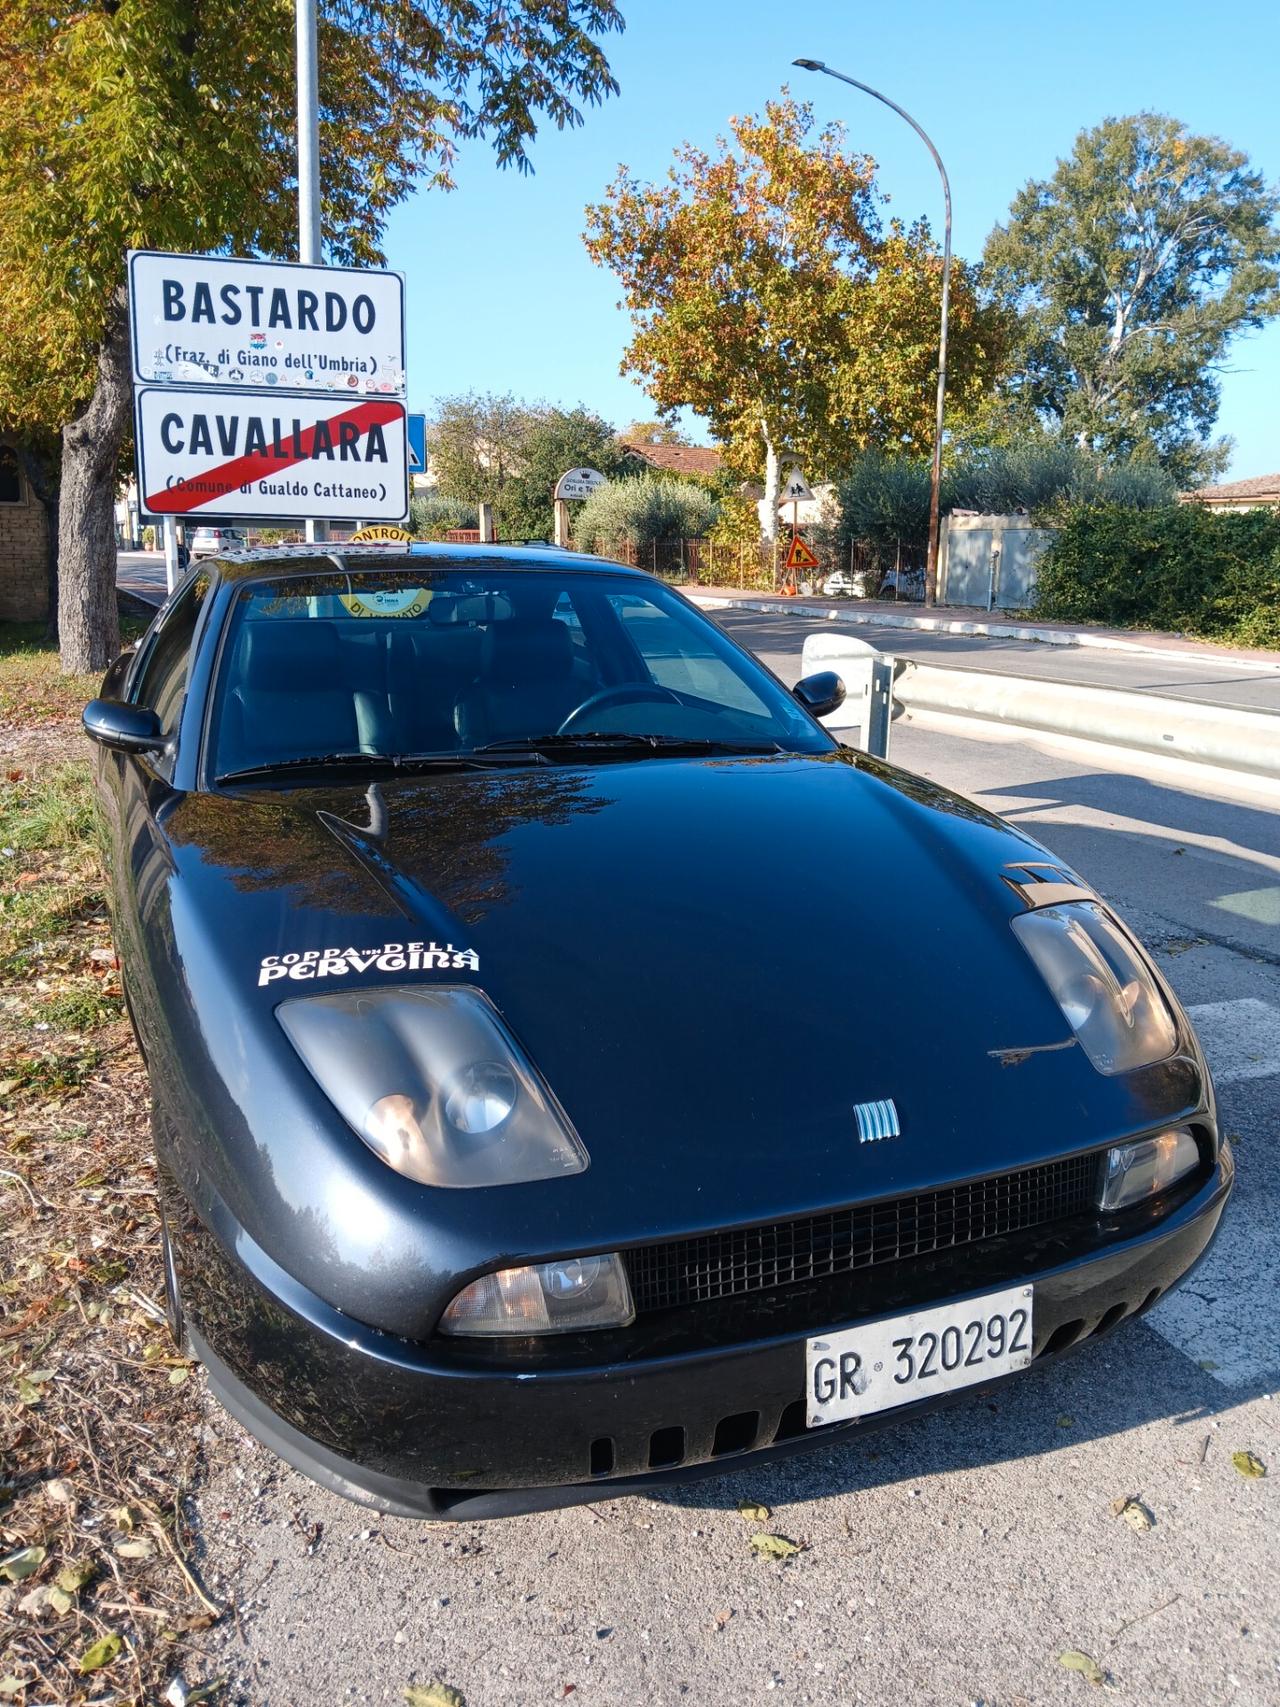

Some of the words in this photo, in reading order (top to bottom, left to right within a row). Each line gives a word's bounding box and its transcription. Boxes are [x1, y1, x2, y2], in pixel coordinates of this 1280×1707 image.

[162, 279, 376, 335] BASTARDO
[165, 343, 210, 364] (Fraz.
[218, 349, 230, 365] di
[237, 350, 278, 368] Giano
[285, 353, 377, 376] dell'Umbria)
[161, 412, 388, 463] CAVALLARA
[166, 475, 233, 494] (Comune
[240, 480, 251, 495] di
[259, 480, 308, 497] Gualdo
[314, 482, 387, 502] Cattaneo)
[261, 946, 361, 968] COPPA
[384, 941, 480, 959] DELLA
[813, 1351, 866, 1405] GR
[892, 1308, 1028, 1385] 320292
